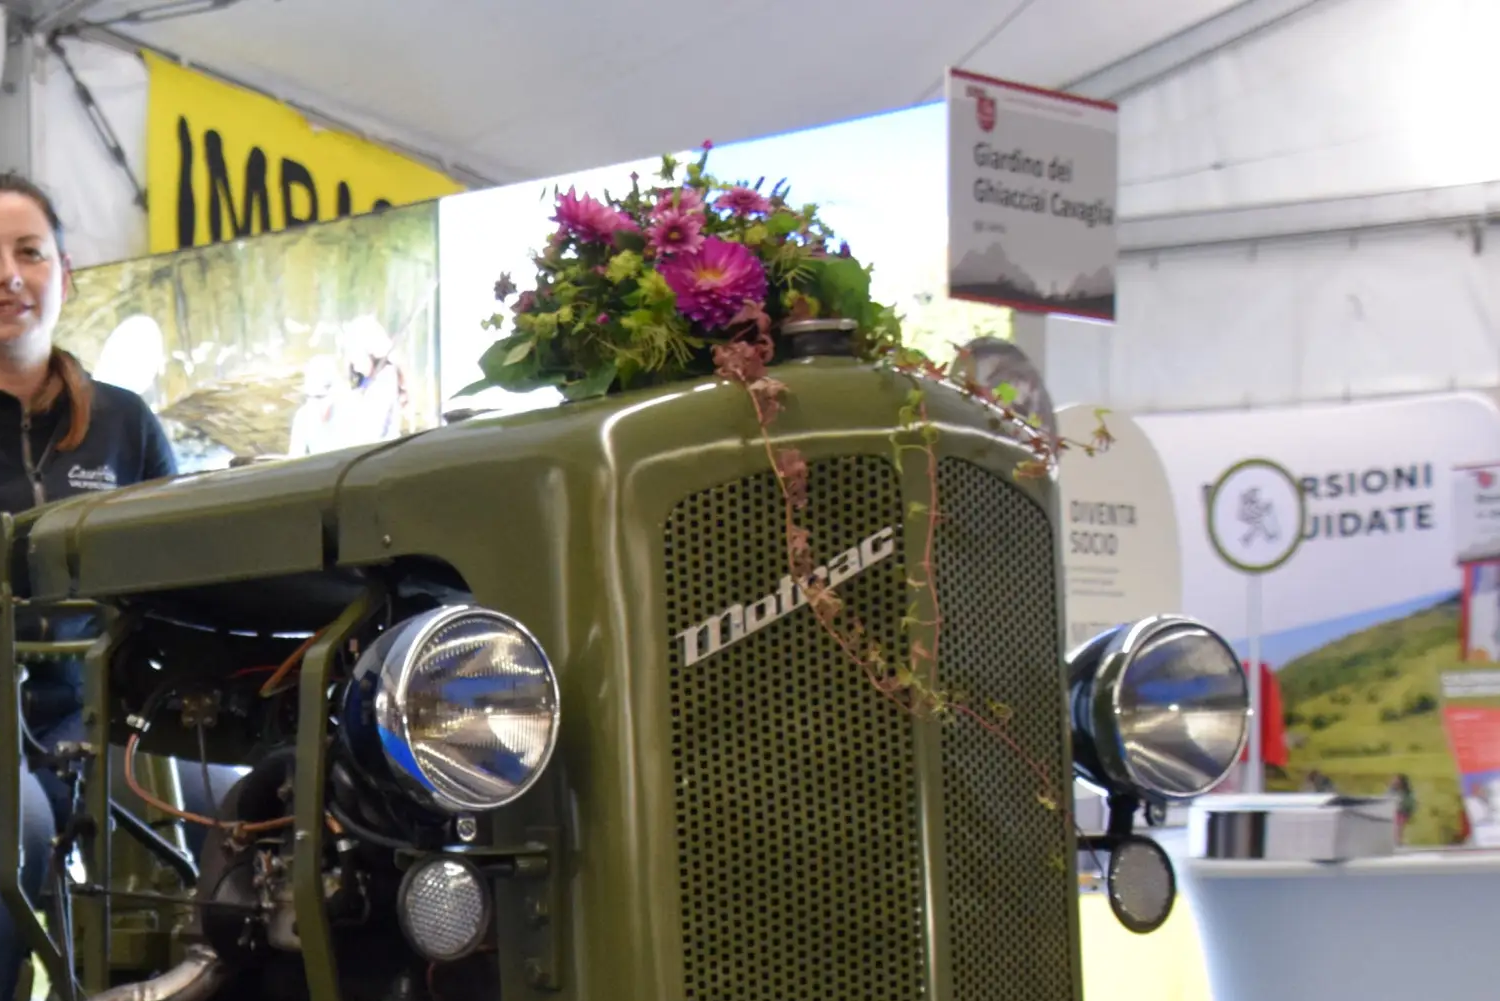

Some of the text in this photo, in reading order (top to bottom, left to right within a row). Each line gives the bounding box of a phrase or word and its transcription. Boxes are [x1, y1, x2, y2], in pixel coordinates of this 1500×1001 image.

[973, 142, 1043, 178] Giardino
[1299, 463, 1434, 498] RSIONI
[1299, 503, 1435, 541] UIDATE
[1070, 531, 1119, 556] SOCIO
